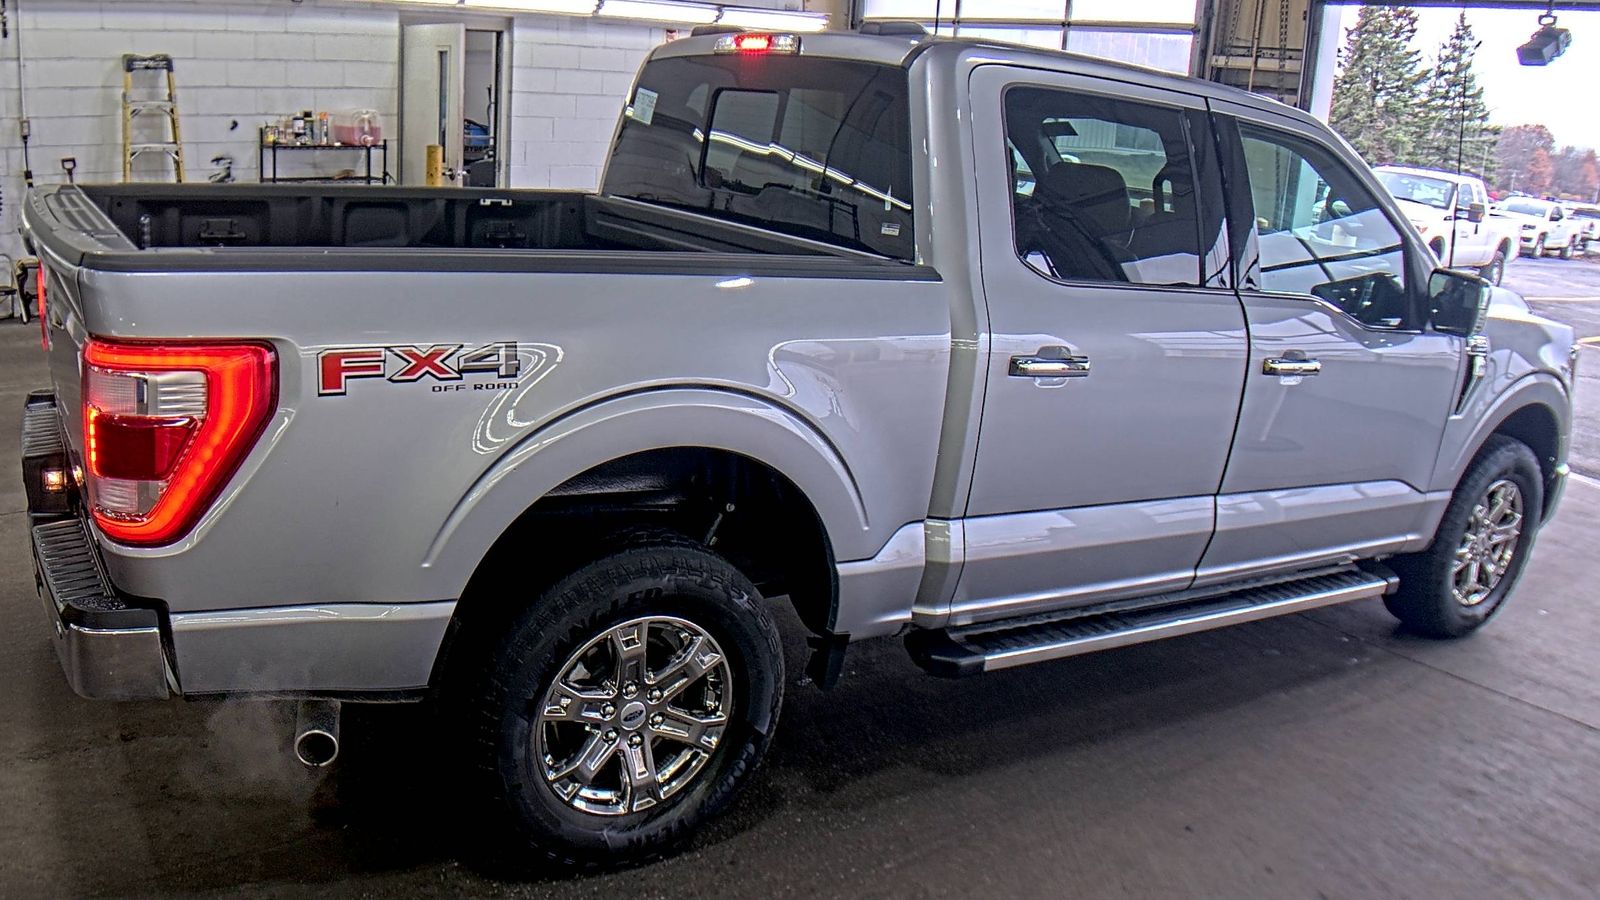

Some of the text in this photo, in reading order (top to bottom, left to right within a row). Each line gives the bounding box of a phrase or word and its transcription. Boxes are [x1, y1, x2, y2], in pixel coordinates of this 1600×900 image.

[317, 341, 520, 397] FX4
[432, 382, 519, 393] OFF ROAD
